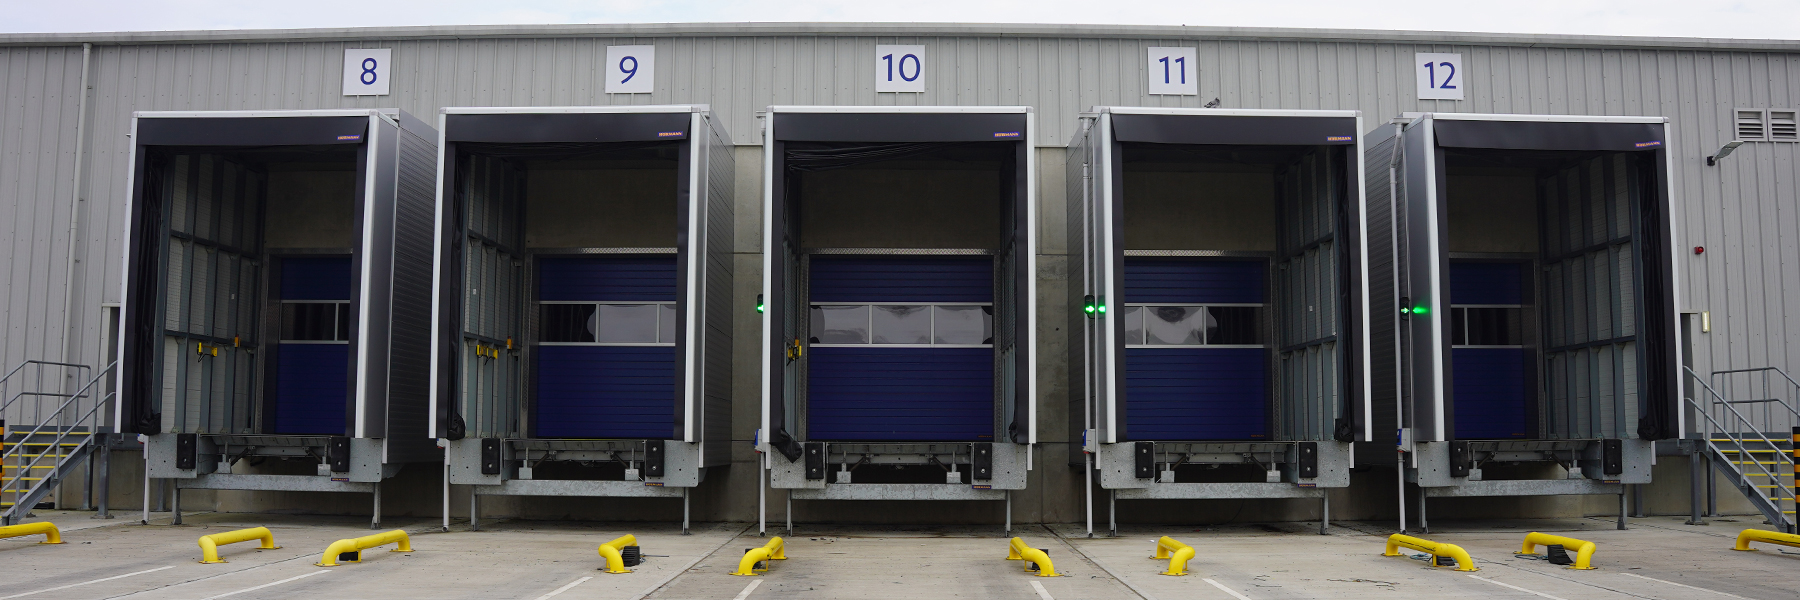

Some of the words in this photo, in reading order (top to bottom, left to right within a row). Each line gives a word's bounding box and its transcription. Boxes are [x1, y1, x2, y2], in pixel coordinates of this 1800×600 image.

[360, 57, 378, 86] 8
[619, 56, 639, 85] 9
[882, 54, 921, 82] 10
[1158, 57, 1186, 85] 11
[1423, 61, 1457, 90] 12
